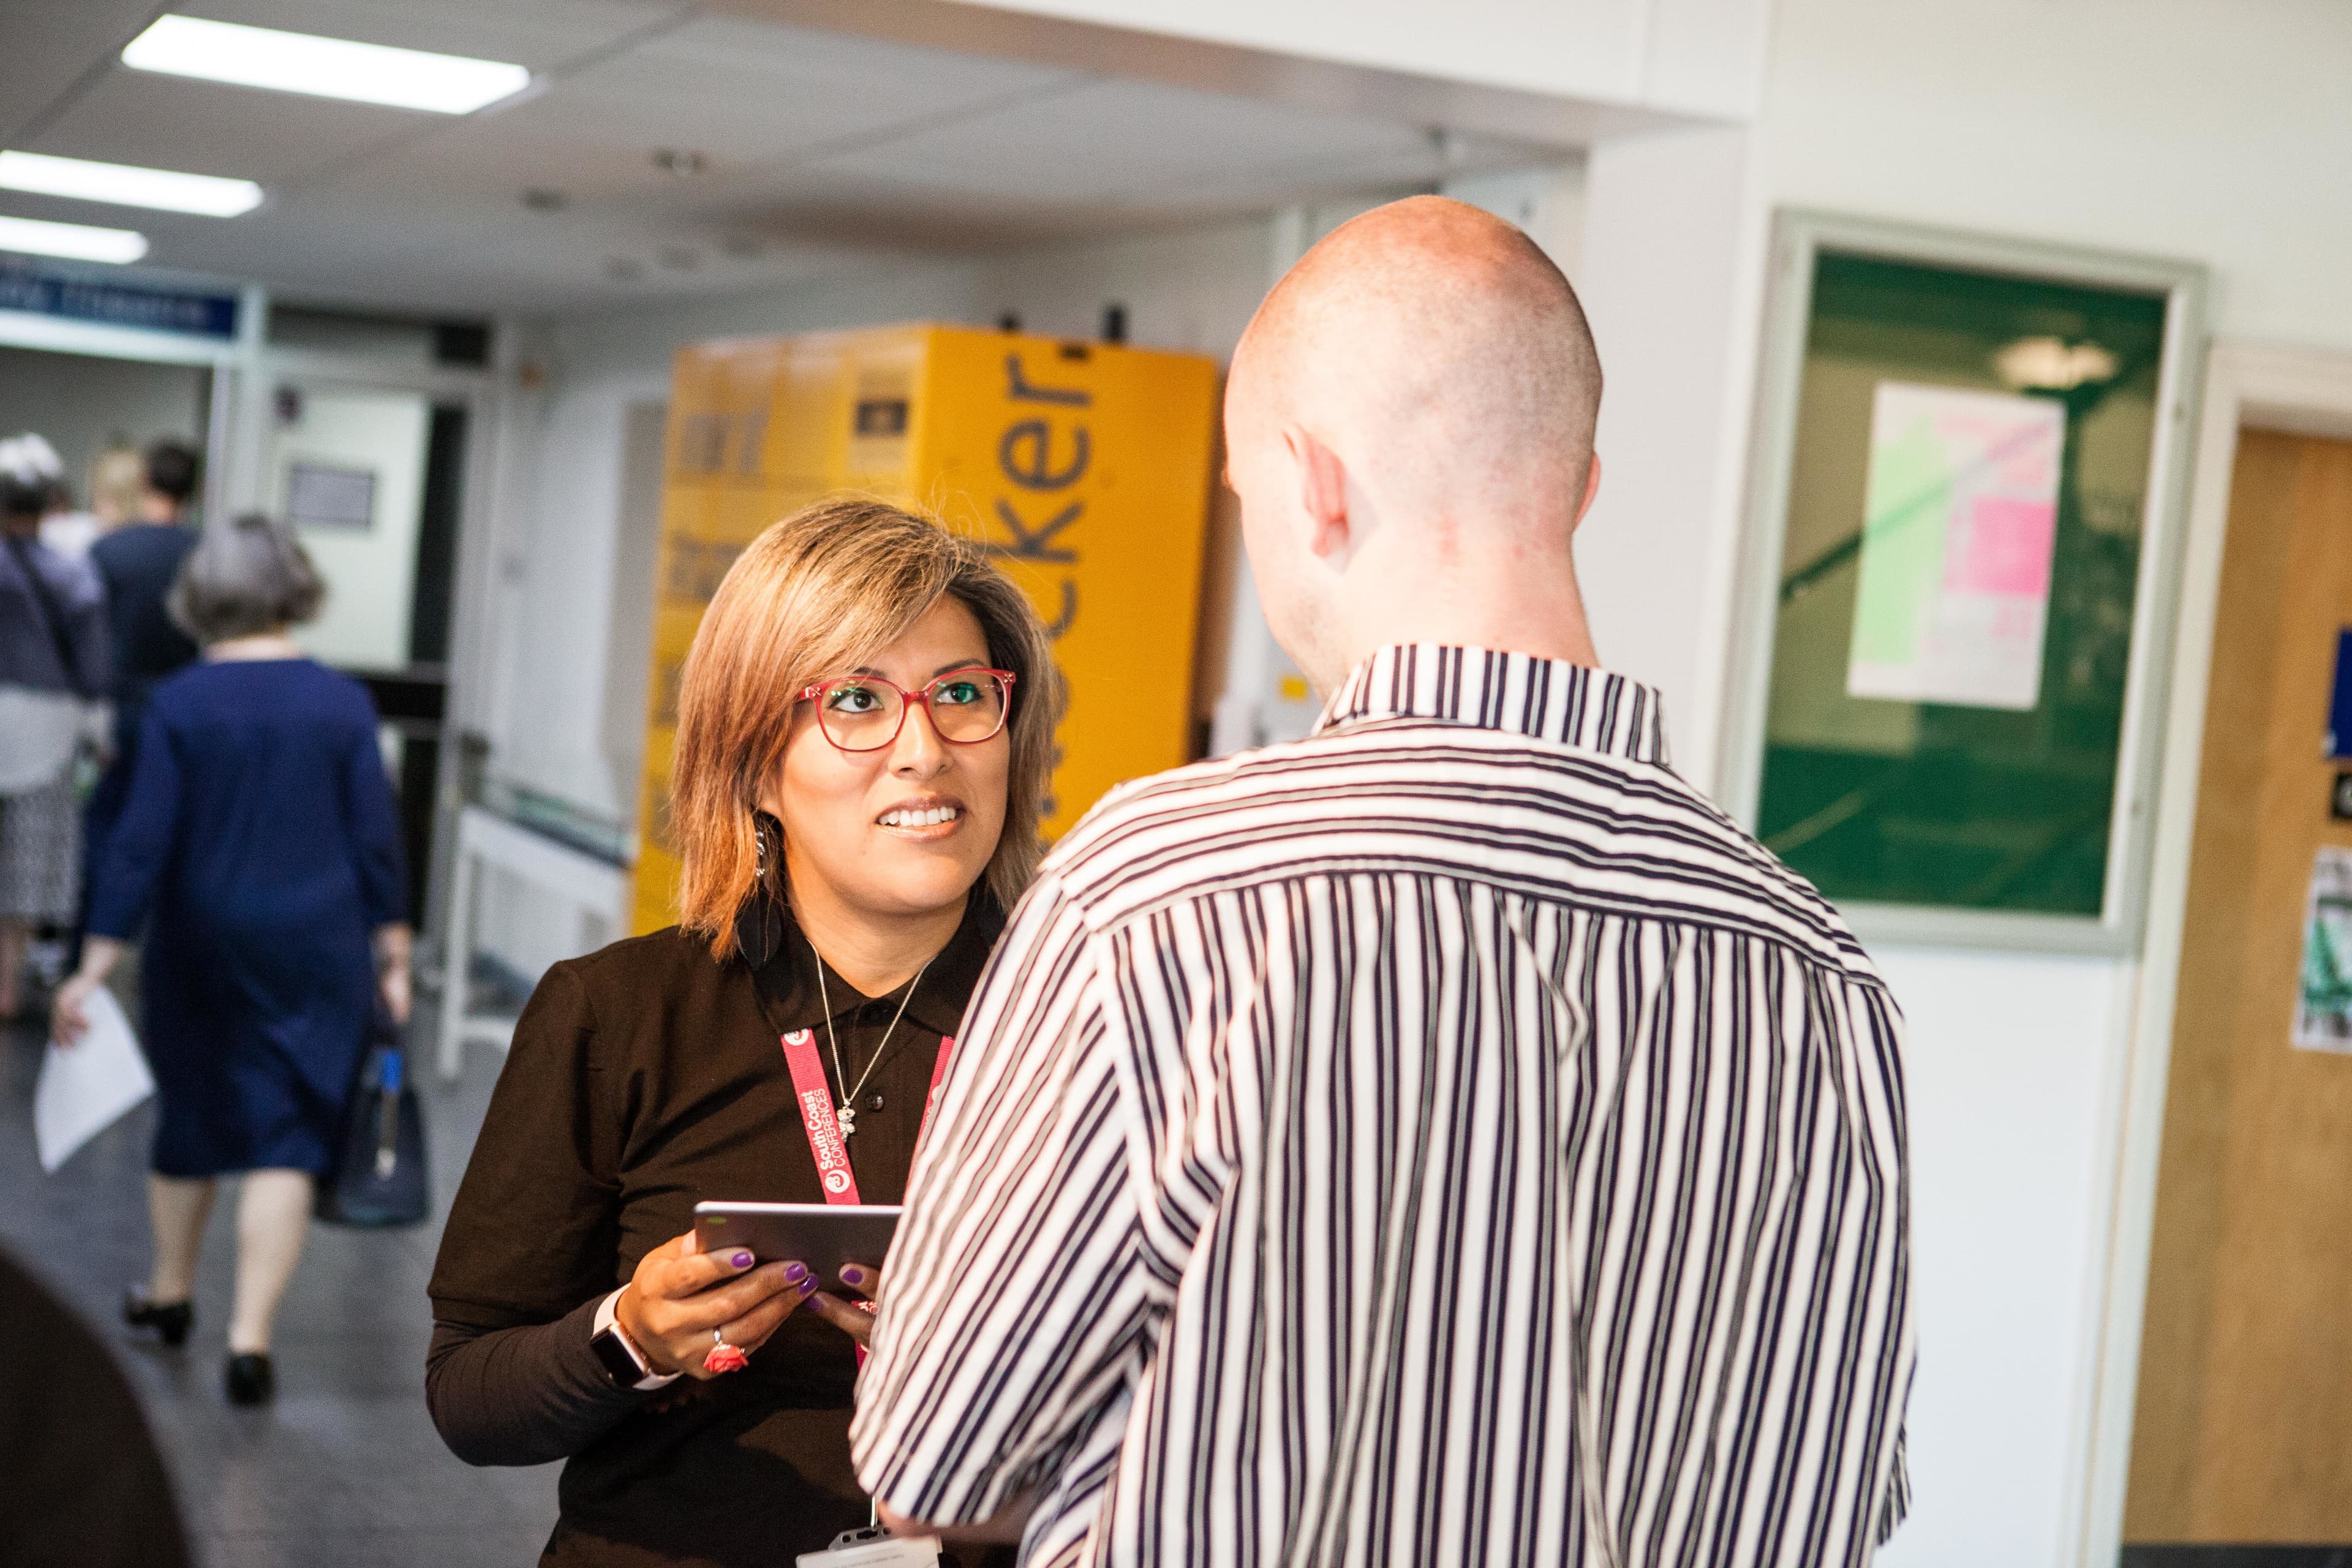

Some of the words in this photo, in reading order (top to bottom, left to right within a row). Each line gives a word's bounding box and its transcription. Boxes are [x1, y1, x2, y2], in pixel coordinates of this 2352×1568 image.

[801, 1091, 822, 1131] Coast
[813, 1088, 846, 1167] CONFERENCES
[812, 1129, 834, 1170] South
